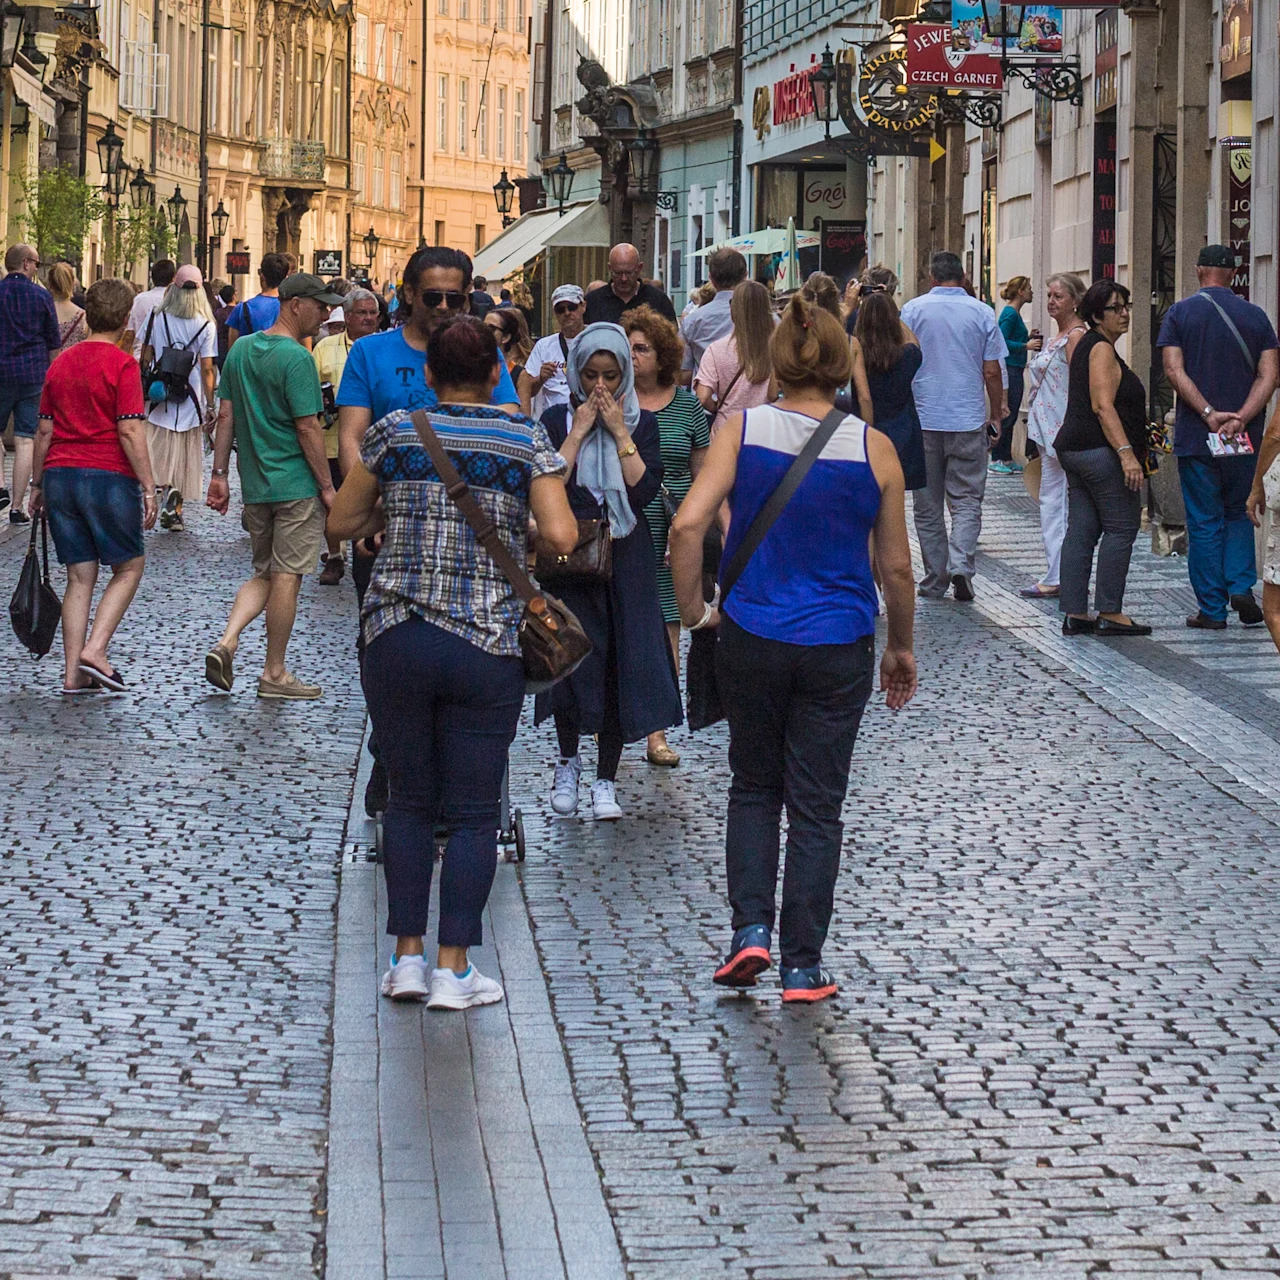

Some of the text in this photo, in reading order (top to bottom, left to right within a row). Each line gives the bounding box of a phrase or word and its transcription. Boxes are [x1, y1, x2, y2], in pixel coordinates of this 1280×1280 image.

[913, 28, 951, 53] JEWE
[911, 70, 998, 85] CZECH GARNET
